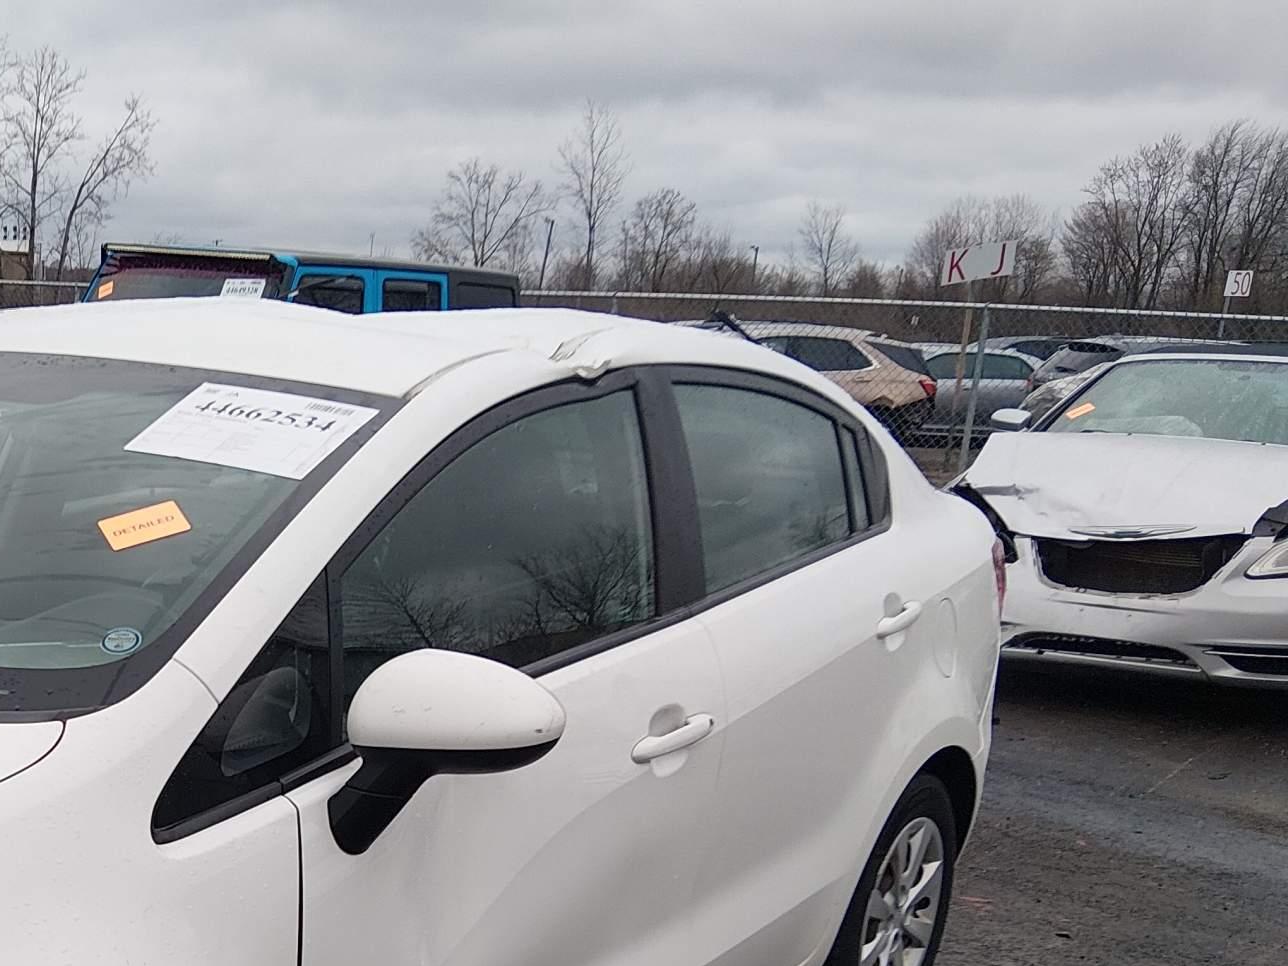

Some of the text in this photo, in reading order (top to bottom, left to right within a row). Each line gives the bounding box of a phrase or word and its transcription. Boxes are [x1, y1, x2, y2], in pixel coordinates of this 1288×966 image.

[948, 243, 1006, 282] K J
[1231, 272, 1251, 295] 50
[195, 400, 336, 432] 44662534
[113, 515, 175, 537] DETAILED
